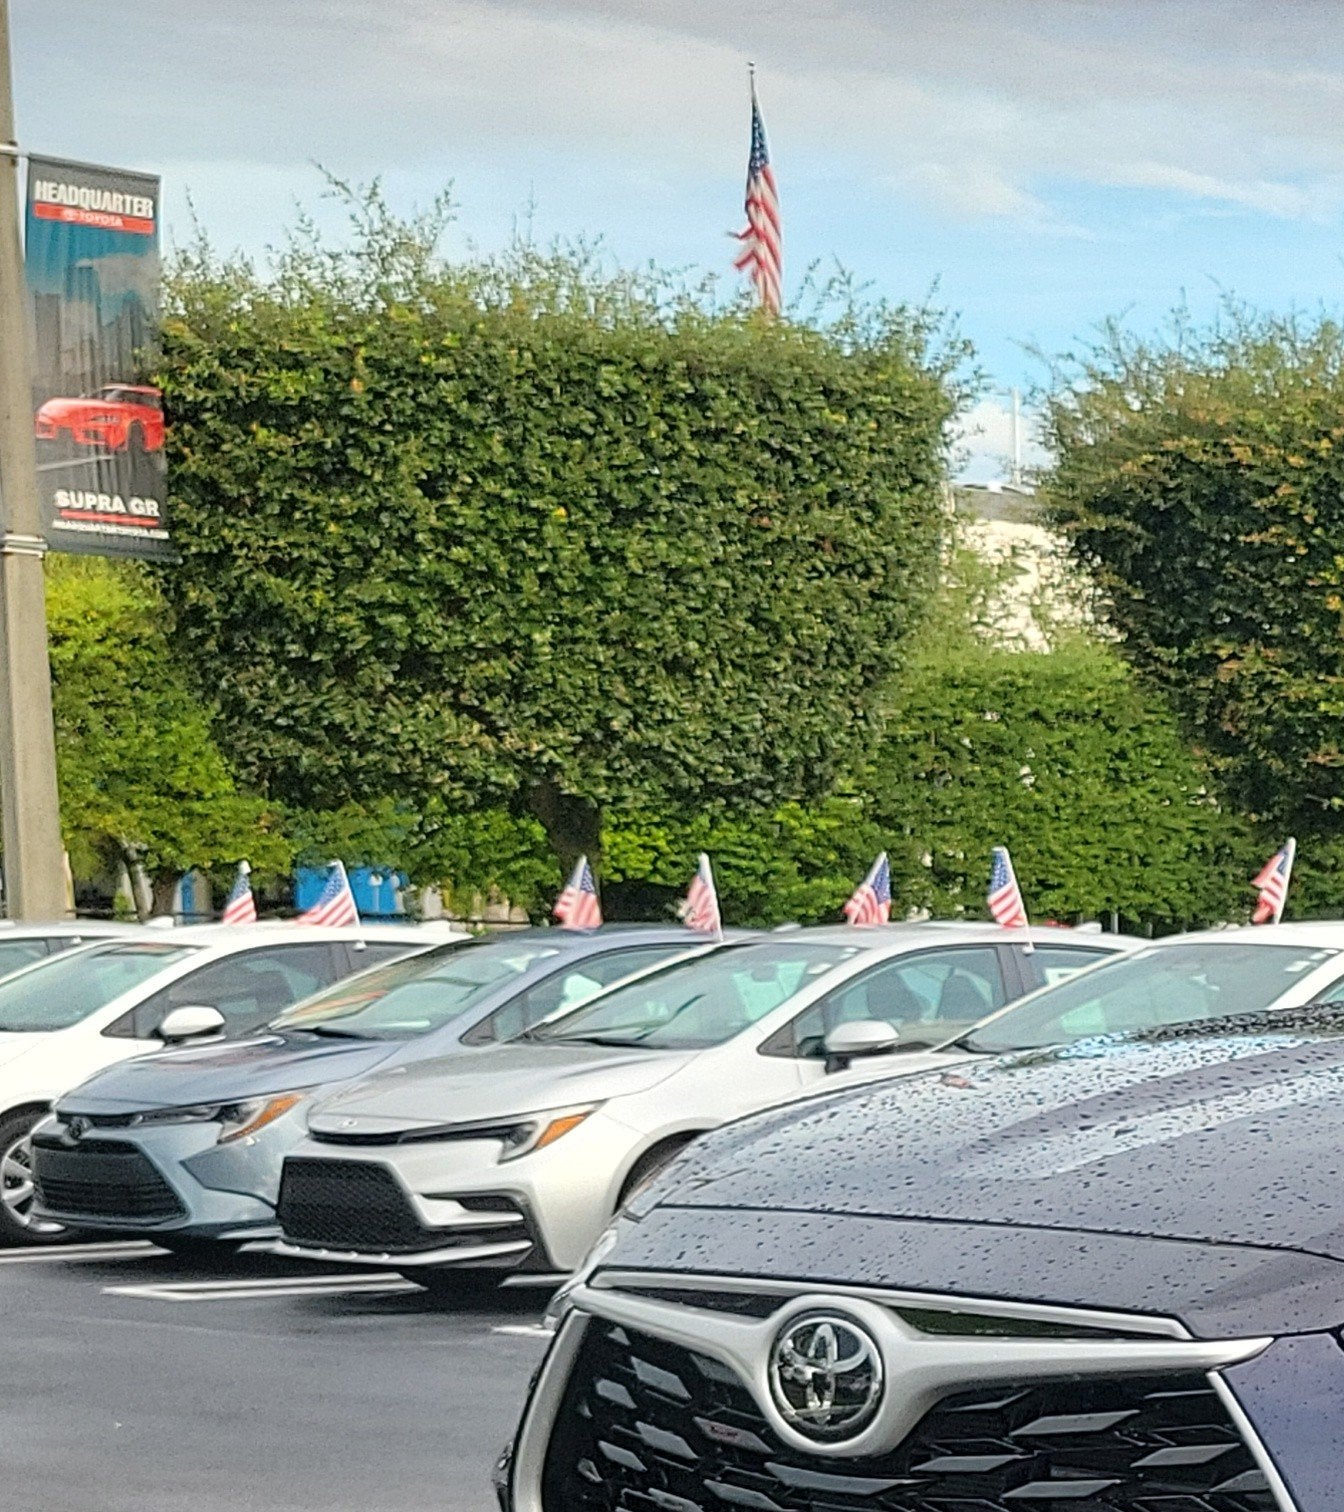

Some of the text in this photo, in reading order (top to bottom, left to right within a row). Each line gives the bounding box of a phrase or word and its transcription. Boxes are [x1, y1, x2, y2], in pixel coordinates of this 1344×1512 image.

[34, 179, 154, 219] HEADQUARTER
[79, 211, 124, 228] TOYOTA
[53, 488, 161, 517] SUPRA GR
